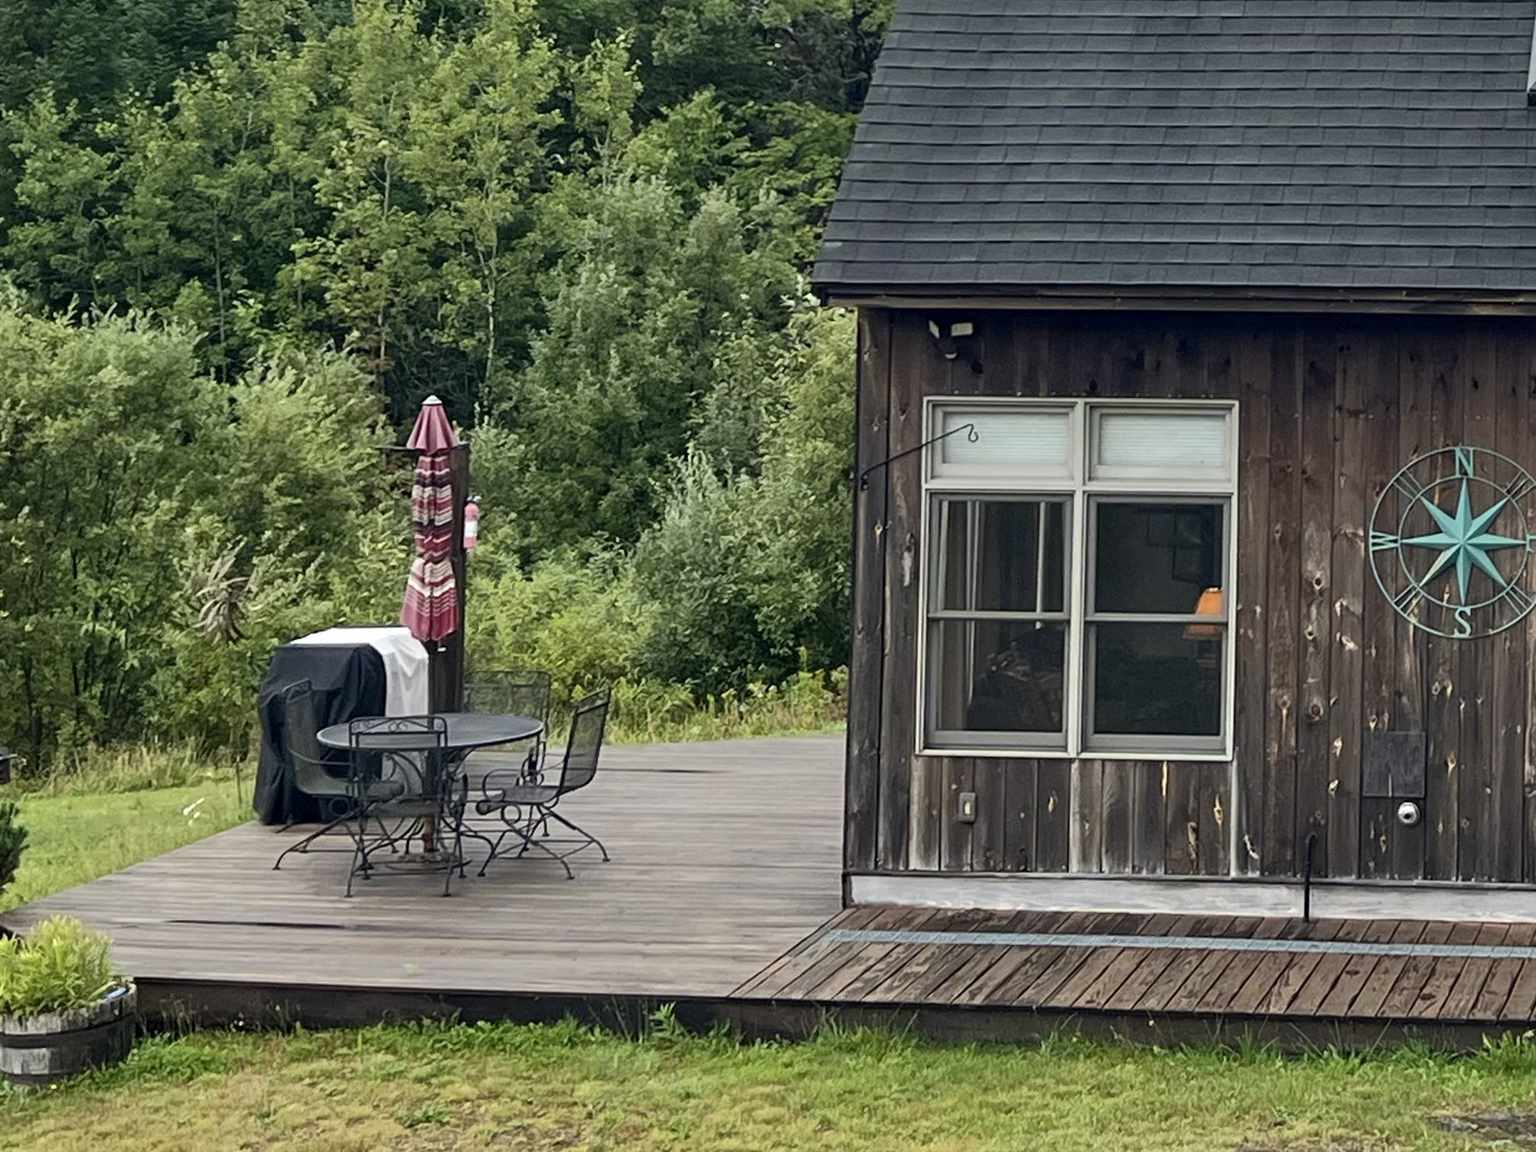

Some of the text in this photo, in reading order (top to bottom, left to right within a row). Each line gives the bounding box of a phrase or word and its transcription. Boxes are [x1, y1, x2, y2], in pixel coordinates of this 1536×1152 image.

[1455, 447, 1474, 478] N
[1369, 530, 1400, 552] W
[1454, 606, 1473, 638] S
